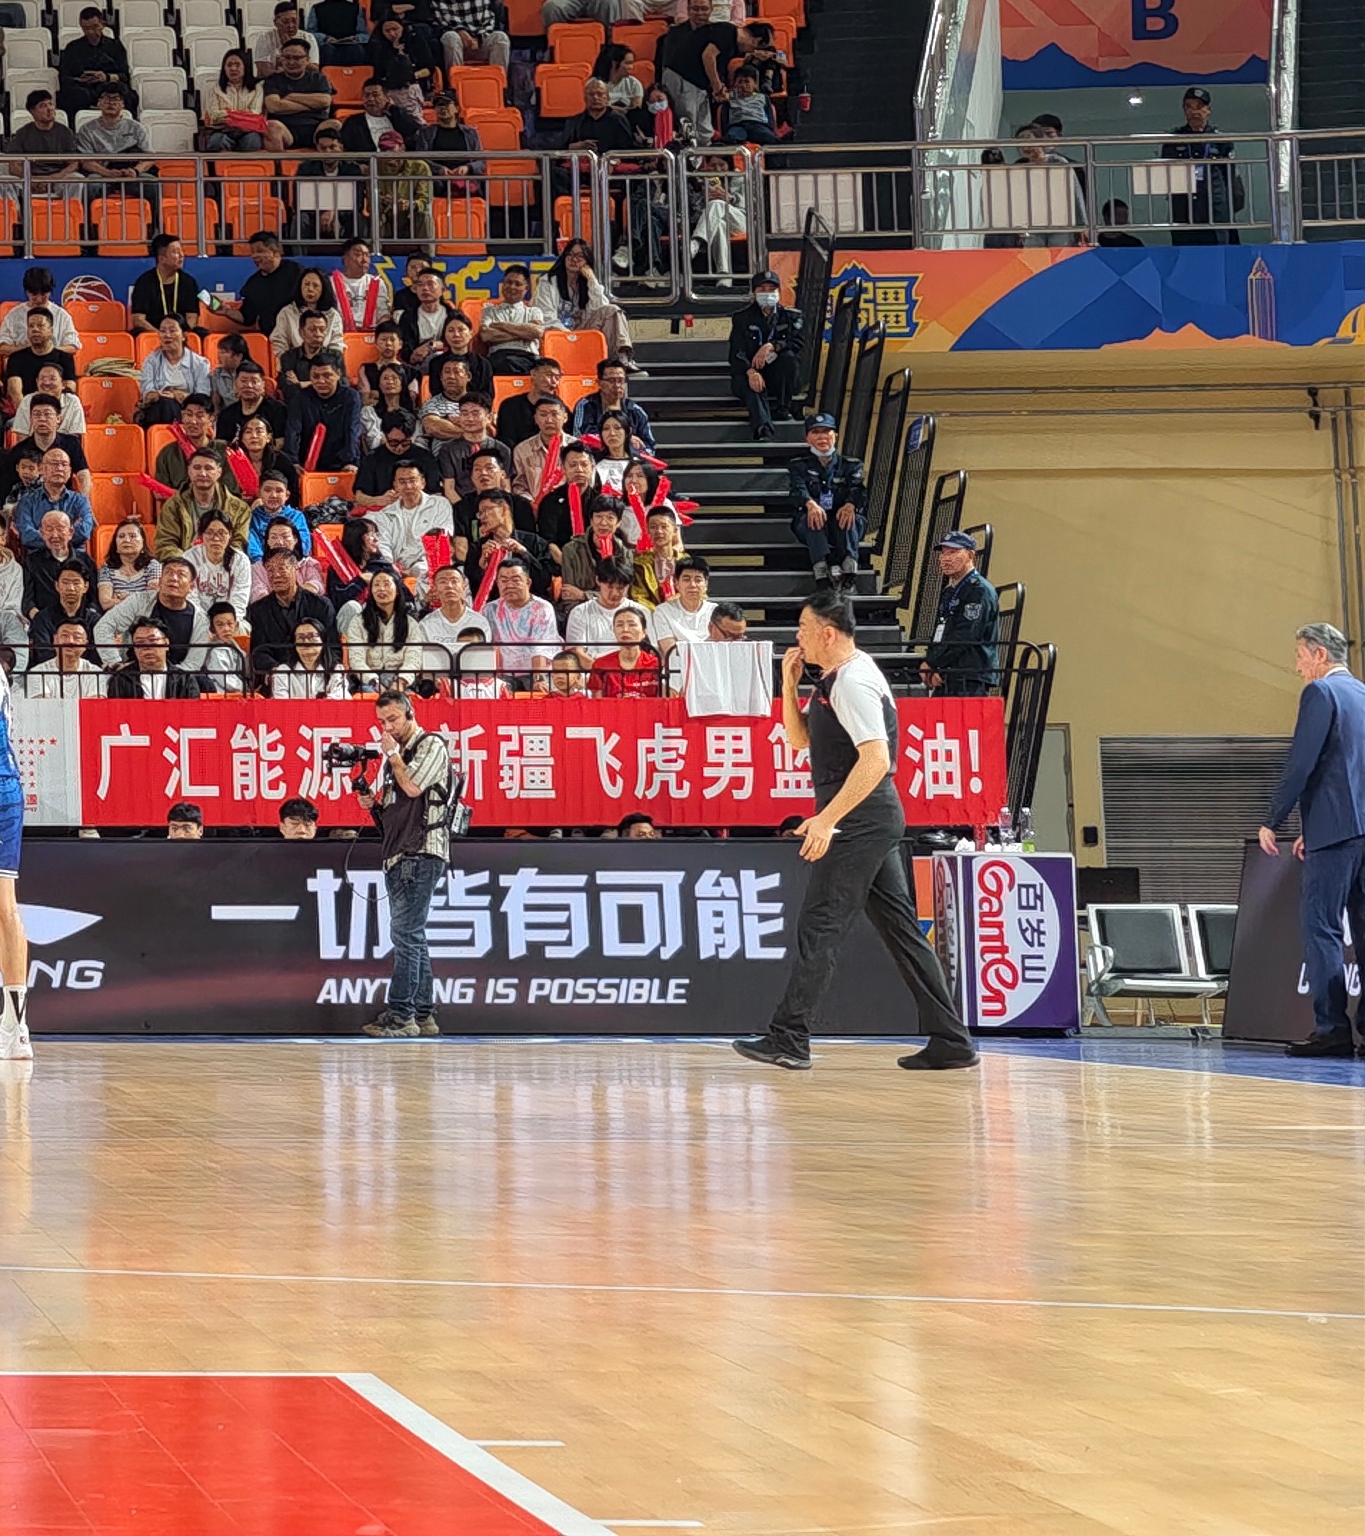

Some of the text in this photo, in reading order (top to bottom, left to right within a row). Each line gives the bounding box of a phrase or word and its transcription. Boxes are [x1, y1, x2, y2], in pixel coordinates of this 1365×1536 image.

[211, 867, 789, 961] 一切皆有可能
[1016, 882, 1047, 985] 百岁山
[316, 977, 691, 1005] ANYTNG IS POSSIBLE
